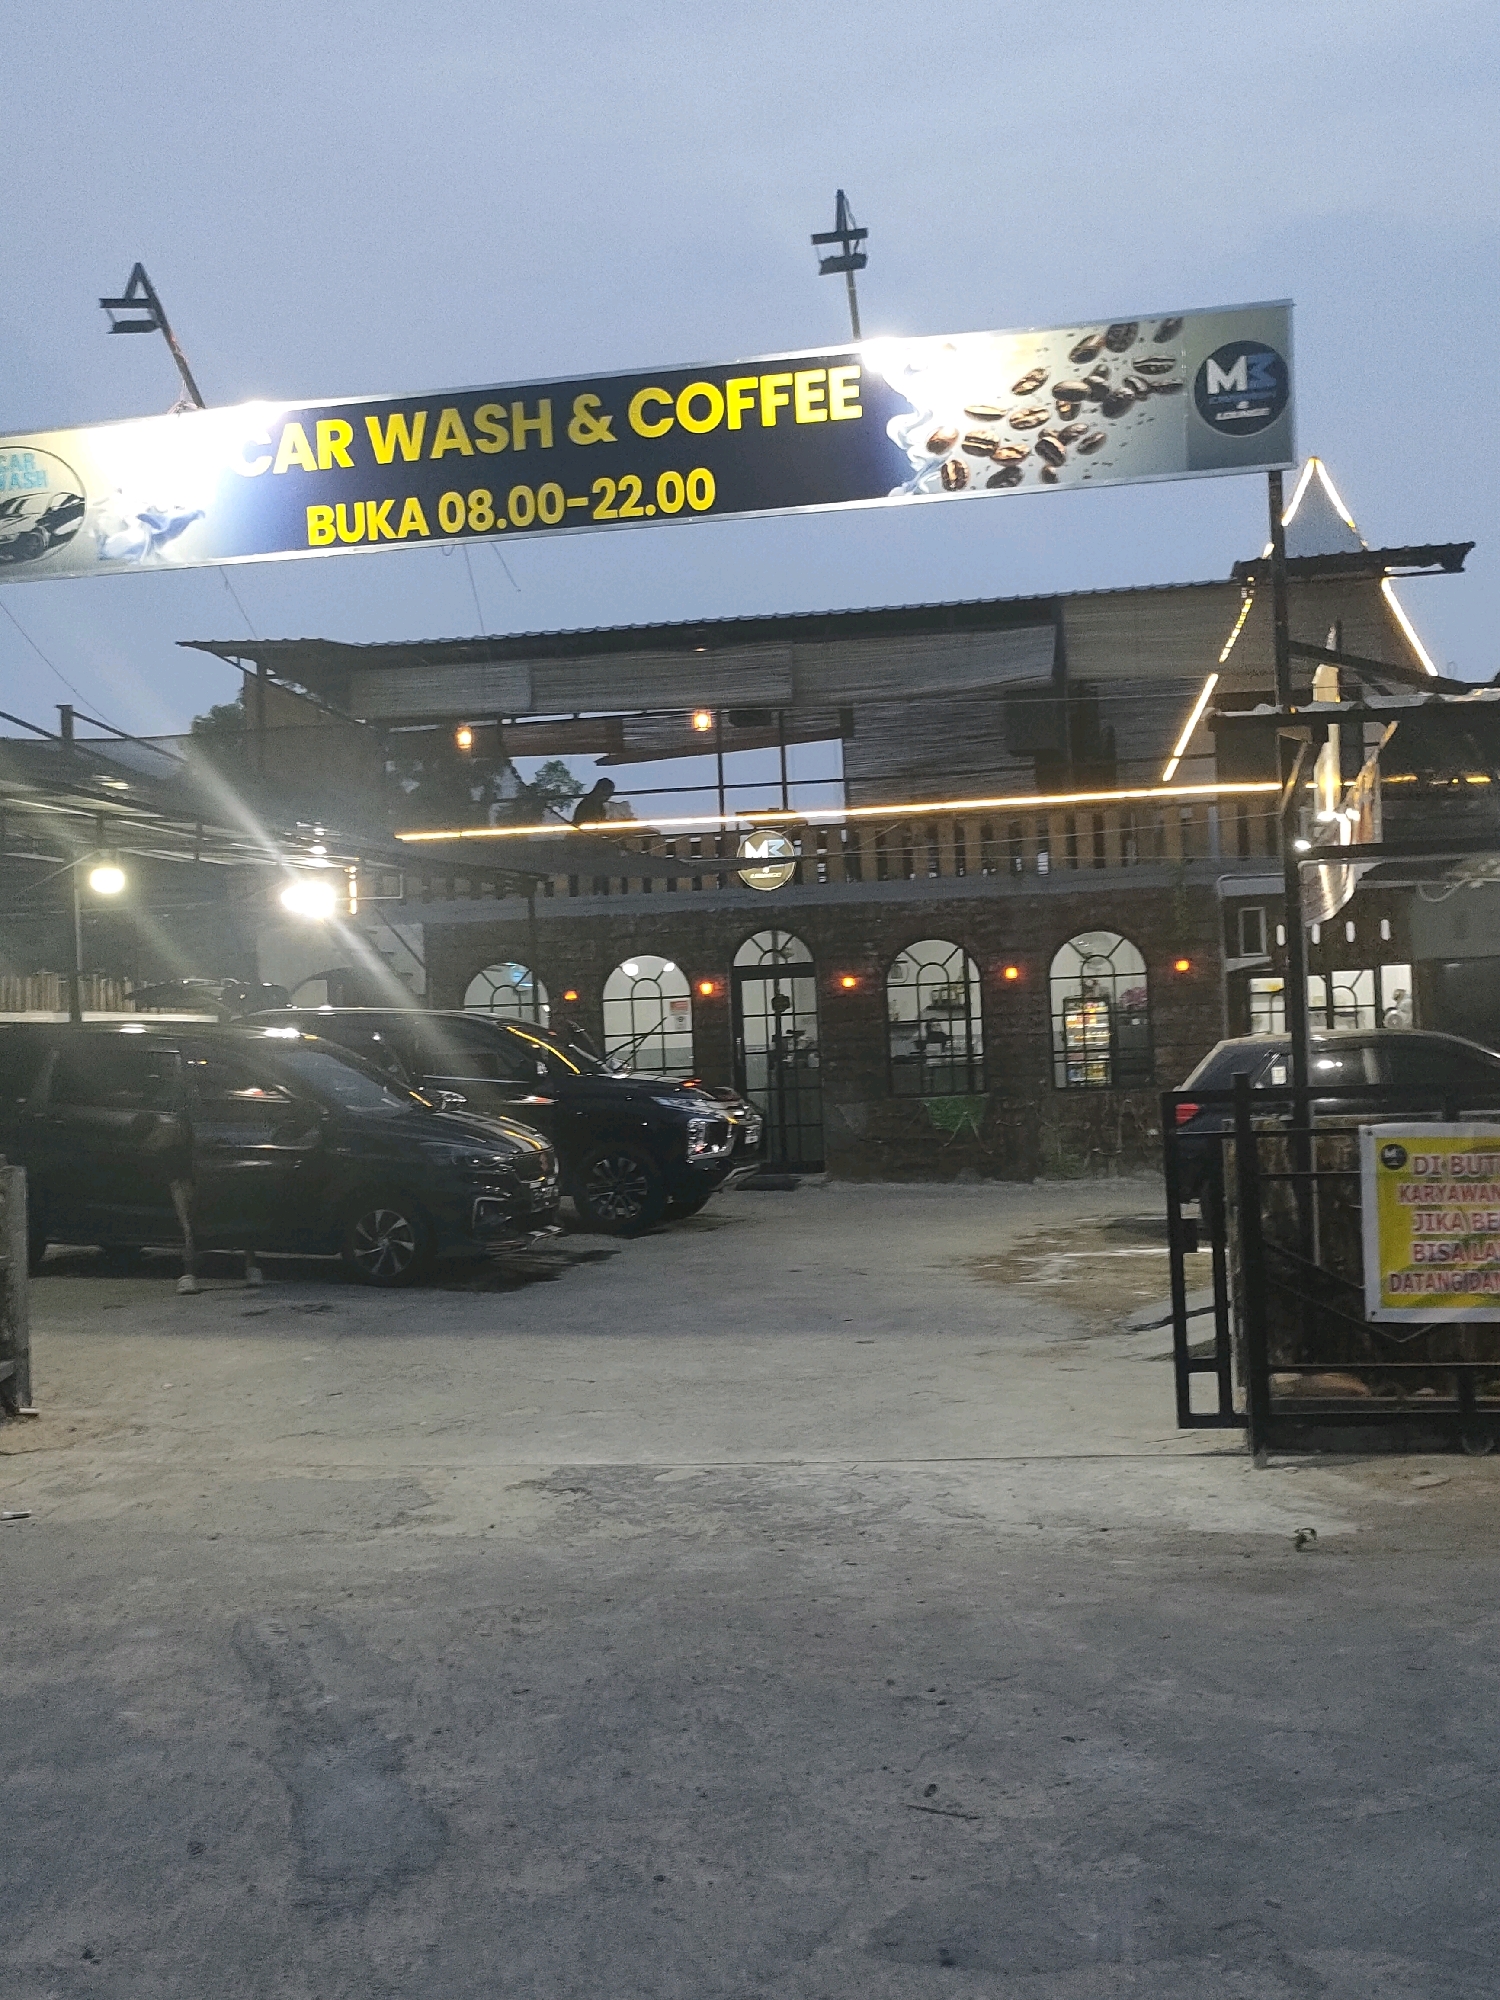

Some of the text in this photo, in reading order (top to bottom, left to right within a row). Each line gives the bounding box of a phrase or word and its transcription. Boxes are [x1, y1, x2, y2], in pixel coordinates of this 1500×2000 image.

[232, 365, 863, 478] CAR WASH & COFFEE
[306, 497, 431, 546] BUKA
[1412, 1154, 1500, 1176] DI BUT
[1412, 1212, 1466, 1233] JIKA
[1412, 1242, 1500, 1263] BISA LA
